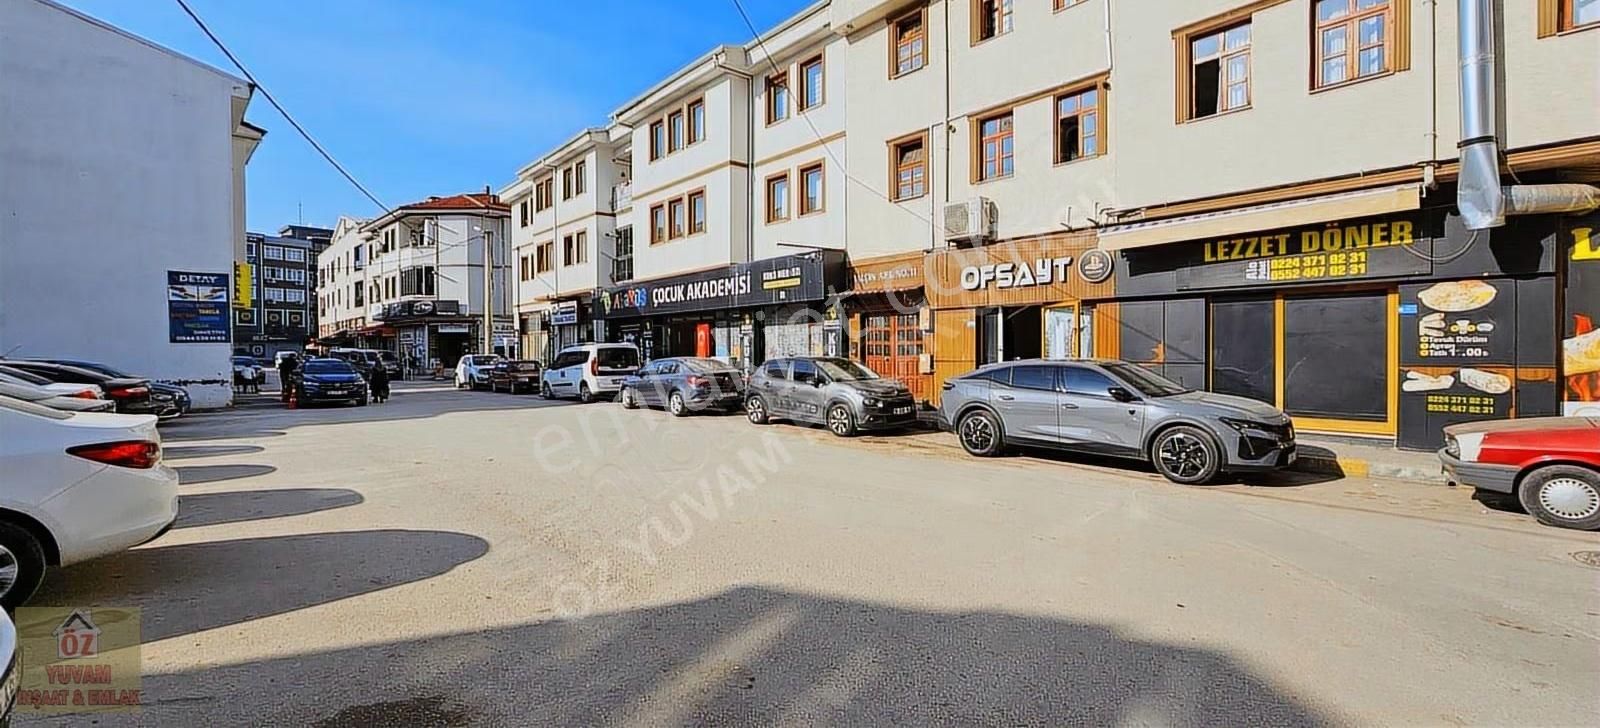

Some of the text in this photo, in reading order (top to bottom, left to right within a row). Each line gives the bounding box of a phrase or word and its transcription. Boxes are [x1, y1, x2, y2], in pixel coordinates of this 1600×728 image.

[1204, 221, 1413, 262] LEZZET DÖNER
[1303, 255, 1325, 267] 371
[1349, 252, 1366, 263] 31
[1349, 263, 1366, 274] 31
[179, 275, 218, 283] DETAY
[961, 257, 1072, 290] OFSAYT
[653, 284, 684, 307] ÇOCUK
[687, 271, 751, 302] AKADEMİSİ
